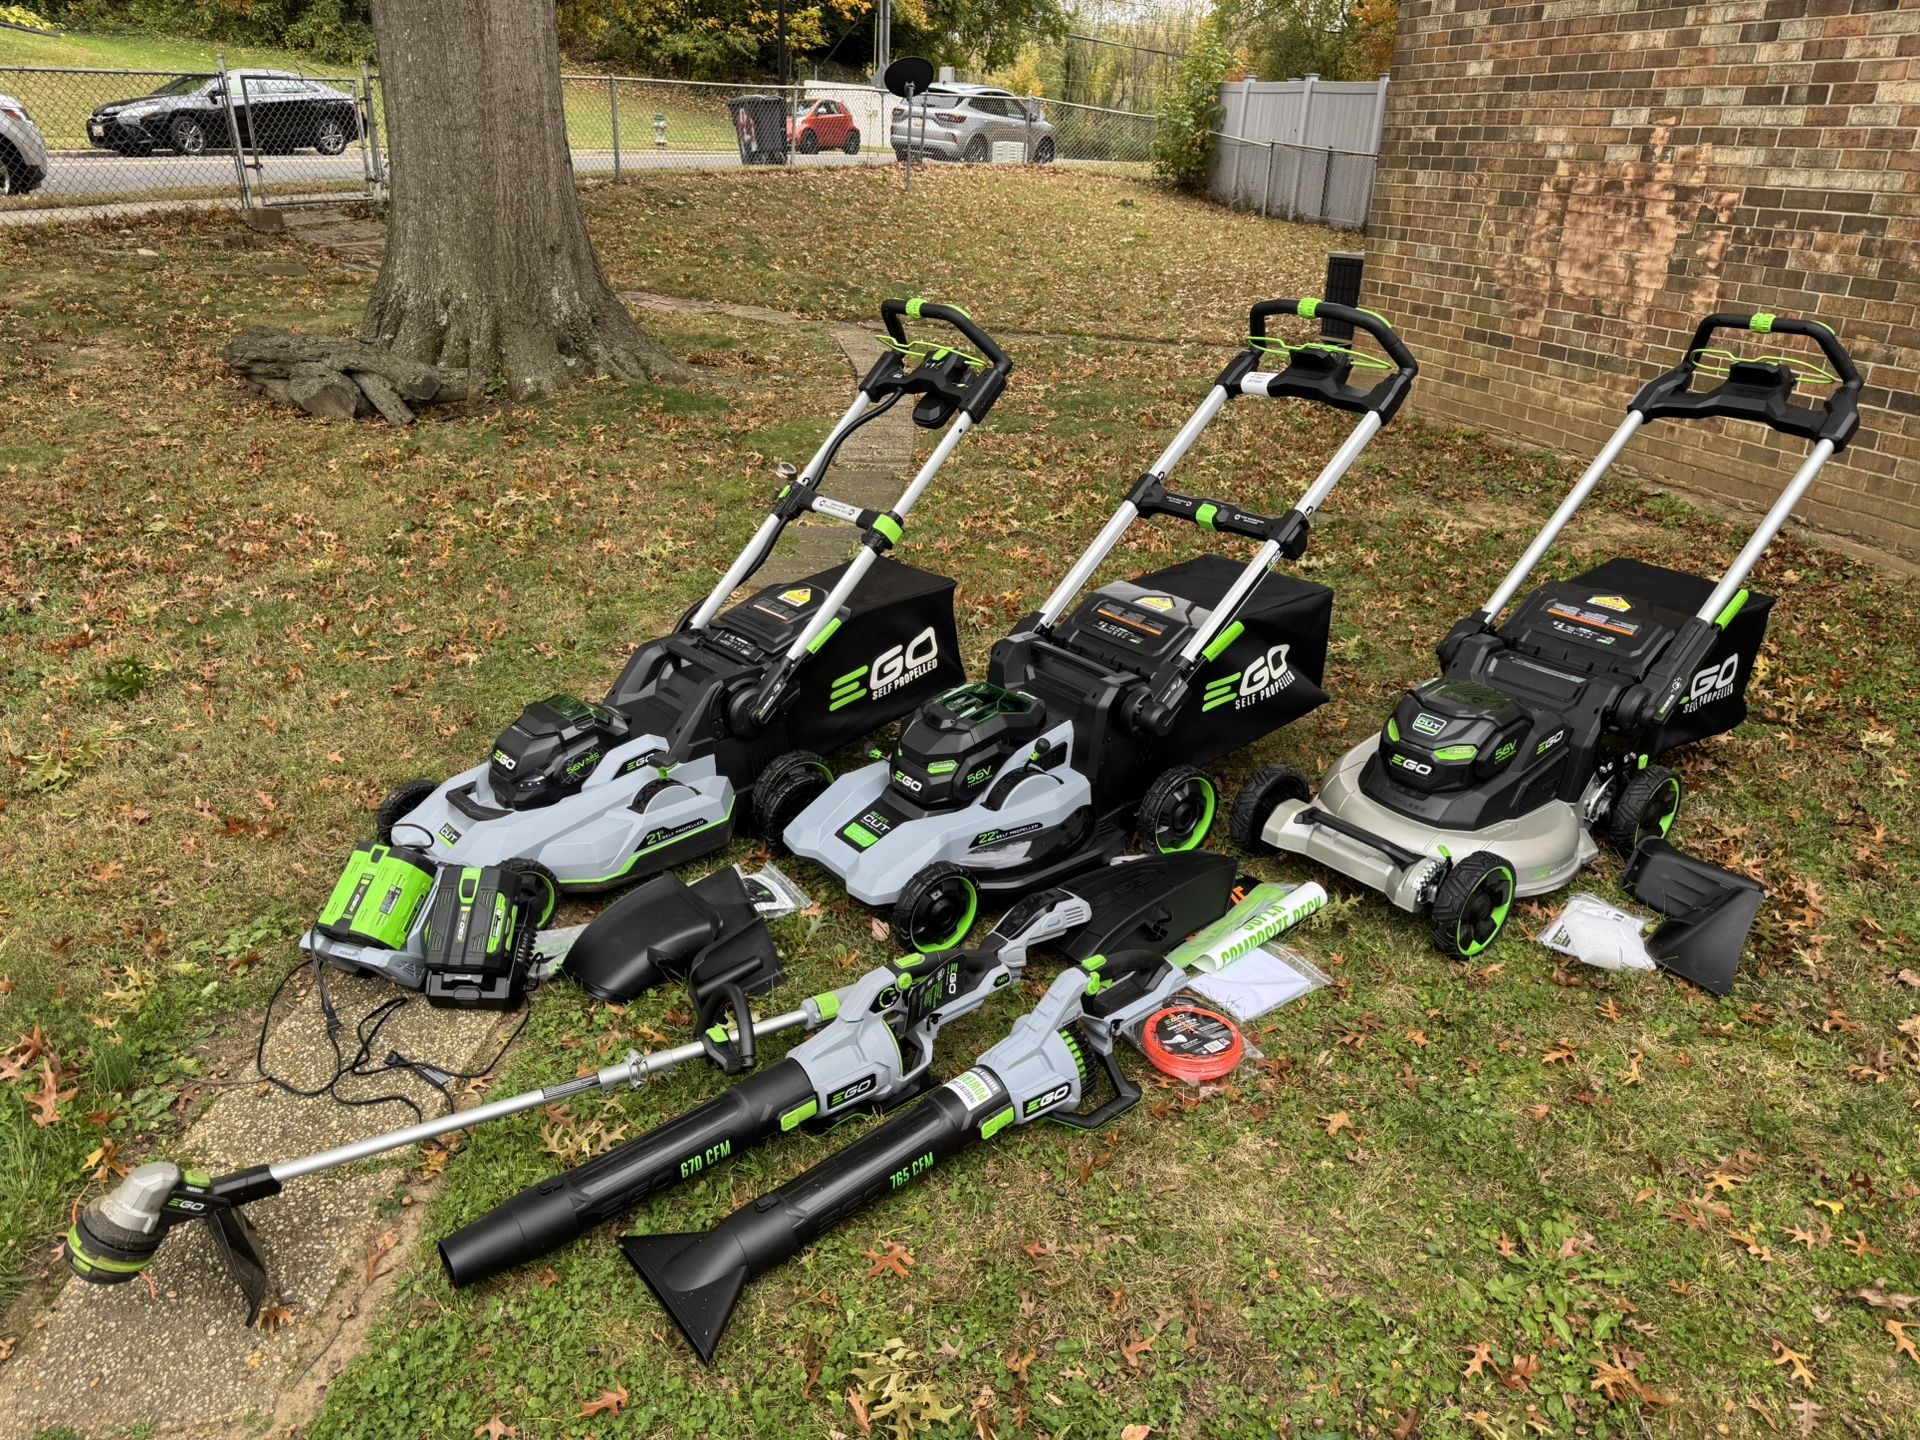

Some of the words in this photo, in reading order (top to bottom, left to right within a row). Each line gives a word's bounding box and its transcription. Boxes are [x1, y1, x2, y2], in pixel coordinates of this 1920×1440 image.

[829, 626, 939, 712] EGO
[872, 683, 894, 701] SELF
[893, 658, 938, 691] PROPELLED
[1201, 643, 1291, 713] EGO
[1678, 652, 1739, 705] GO
[1235, 693, 1257, 710] SELF
[1417, 718, 1442, 730] CUT
[1494, 739, 1518, 761] 56V
[1536, 729, 1564, 756] EGO
[494, 749, 517, 771] EGO
[565, 759, 586, 776] 56V
[1391, 753, 1433, 776] EGO
[894, 770, 923, 792] EGO
[966, 765, 992, 785] 56V
[662, 831, 676, 840] SELF
[675, 819, 704, 834] PROPELLED
[862, 814, 891, 832] CUT
[1009, 823, 1039, 836] PROPELLED
[440, 827, 458, 842] CUT
[948, 962, 959, 994] EGO
[831, 1079, 872, 1106] EGO
[1026, 1085, 1069, 1114] EGO
[680, 1154, 703, 1179] 670
[705, 1139, 731, 1165] CFM
[889, 1166, 910, 1189] 765
[911, 1151, 934, 1176] CFM
[167, 1198, 205, 1211] EGO
